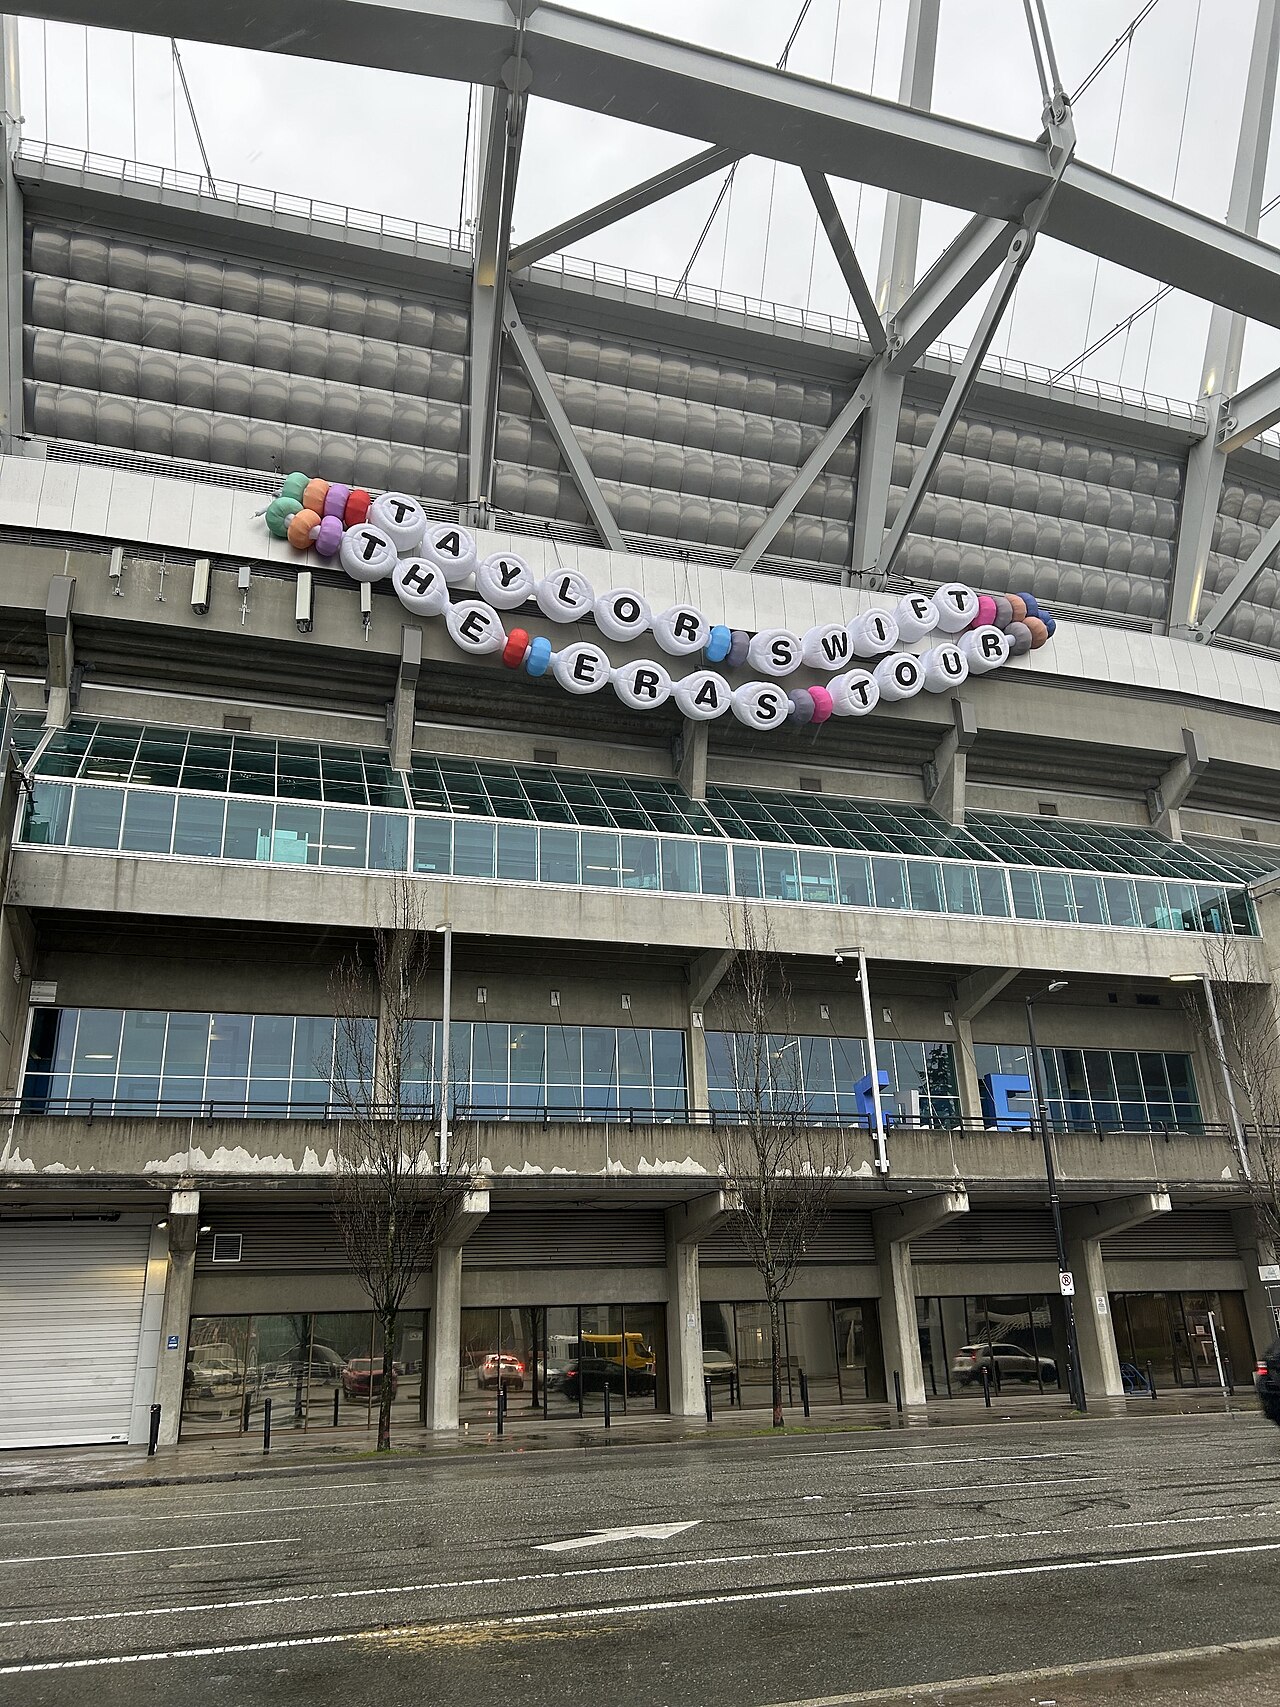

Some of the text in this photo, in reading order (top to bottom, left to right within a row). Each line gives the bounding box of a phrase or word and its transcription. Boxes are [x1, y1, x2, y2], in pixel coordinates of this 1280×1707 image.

[361, 531, 1003, 720] THE ERAS TOUR
[390, 499, 969, 666] TAYLOR SWIFT
